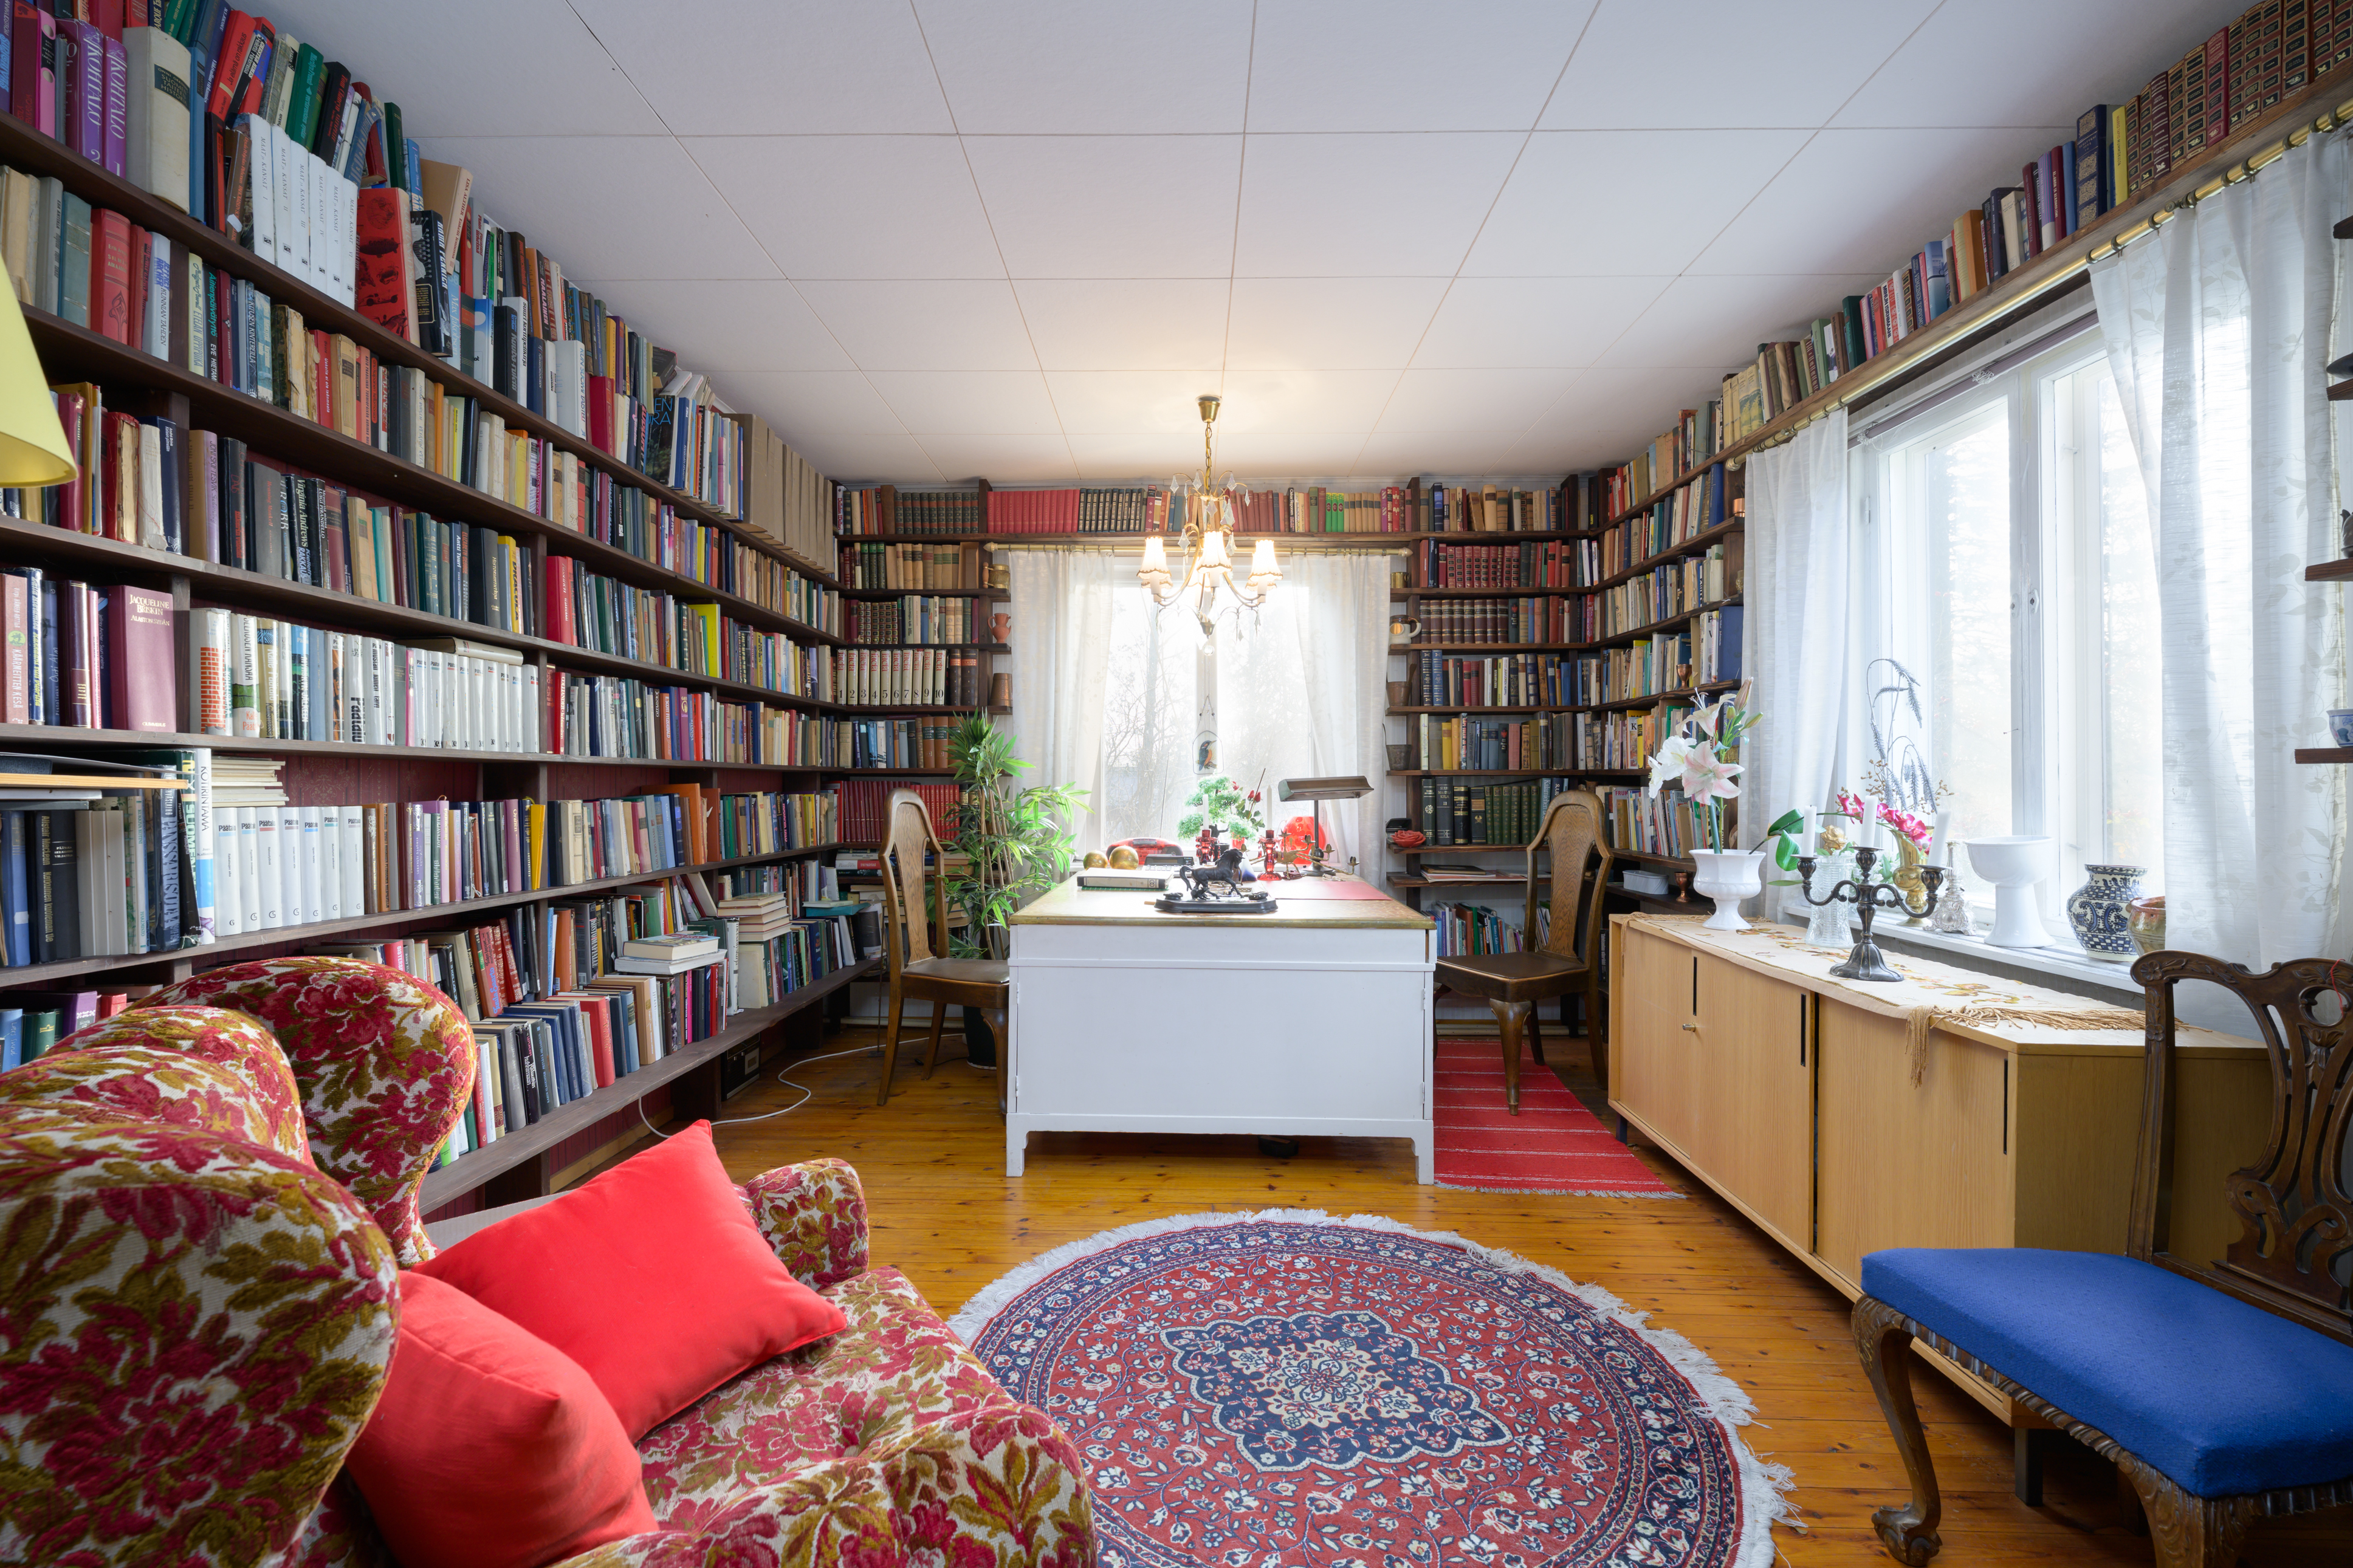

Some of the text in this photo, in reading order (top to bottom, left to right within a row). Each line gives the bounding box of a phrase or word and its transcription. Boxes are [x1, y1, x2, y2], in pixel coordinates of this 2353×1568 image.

[227, 32, 247, 85] Ja elämä on rakkaus
[158, 68, 171, 77] ONNI
[162, 74, 187, 94] SUOMEN
[83, 38, 103, 166] KOHTALO 2
[106, 53, 128, 139] KOHTALO
[154, 257, 163, 286] ARCHER
[208, 272, 218, 337] Äitienpäivätyttö
[540, 277, 549, 325] MAALAINEN
[193, 310, 203, 334] ETELÄN
[452, 313, 460, 356] Jakobson
[194, 335, 203, 368] OPPIPOIKA
[296, 479, 309, 547] Virginia Andrews
[298, 547, 308, 578] RAKKAUS
[129, 594, 170, 609] JACQUELINE
[137, 604, 163, 615] BRISKIN
[131, 614, 170, 626] ALASTON SYDÄN
[49, 647, 59, 682] Outi Alm
[838, 651, 847, 671] facta
[848, 652, 857, 671] facta
[860, 651, 868, 671] facta
[871, 652, 879, 672] facta
[882, 652, 890, 672] facta
[893, 652, 902, 672] facta
[914, 652, 922, 671] facta
[924, 651, 933, 670] facta
[936, 652, 945, 671] facta
[12, 649, 24, 708] KÄÄRMEITTEN KESÄ
[850, 690, 855, 698] 2
[882, 690, 888, 698] 5
[894, 690, 899, 698] 6
[904, 690, 909, 698] 7
[924, 688, 929, 697] 9
[935, 690, 943, 698] 10
[201, 766, 210, 831] KOTIRINTAMA
[41, 816, 50, 837] Alistair
[44, 903, 53, 933] kuoleman
[46, 933, 54, 942] tie
[488, 968, 501, 1014] Tuula Saarto
